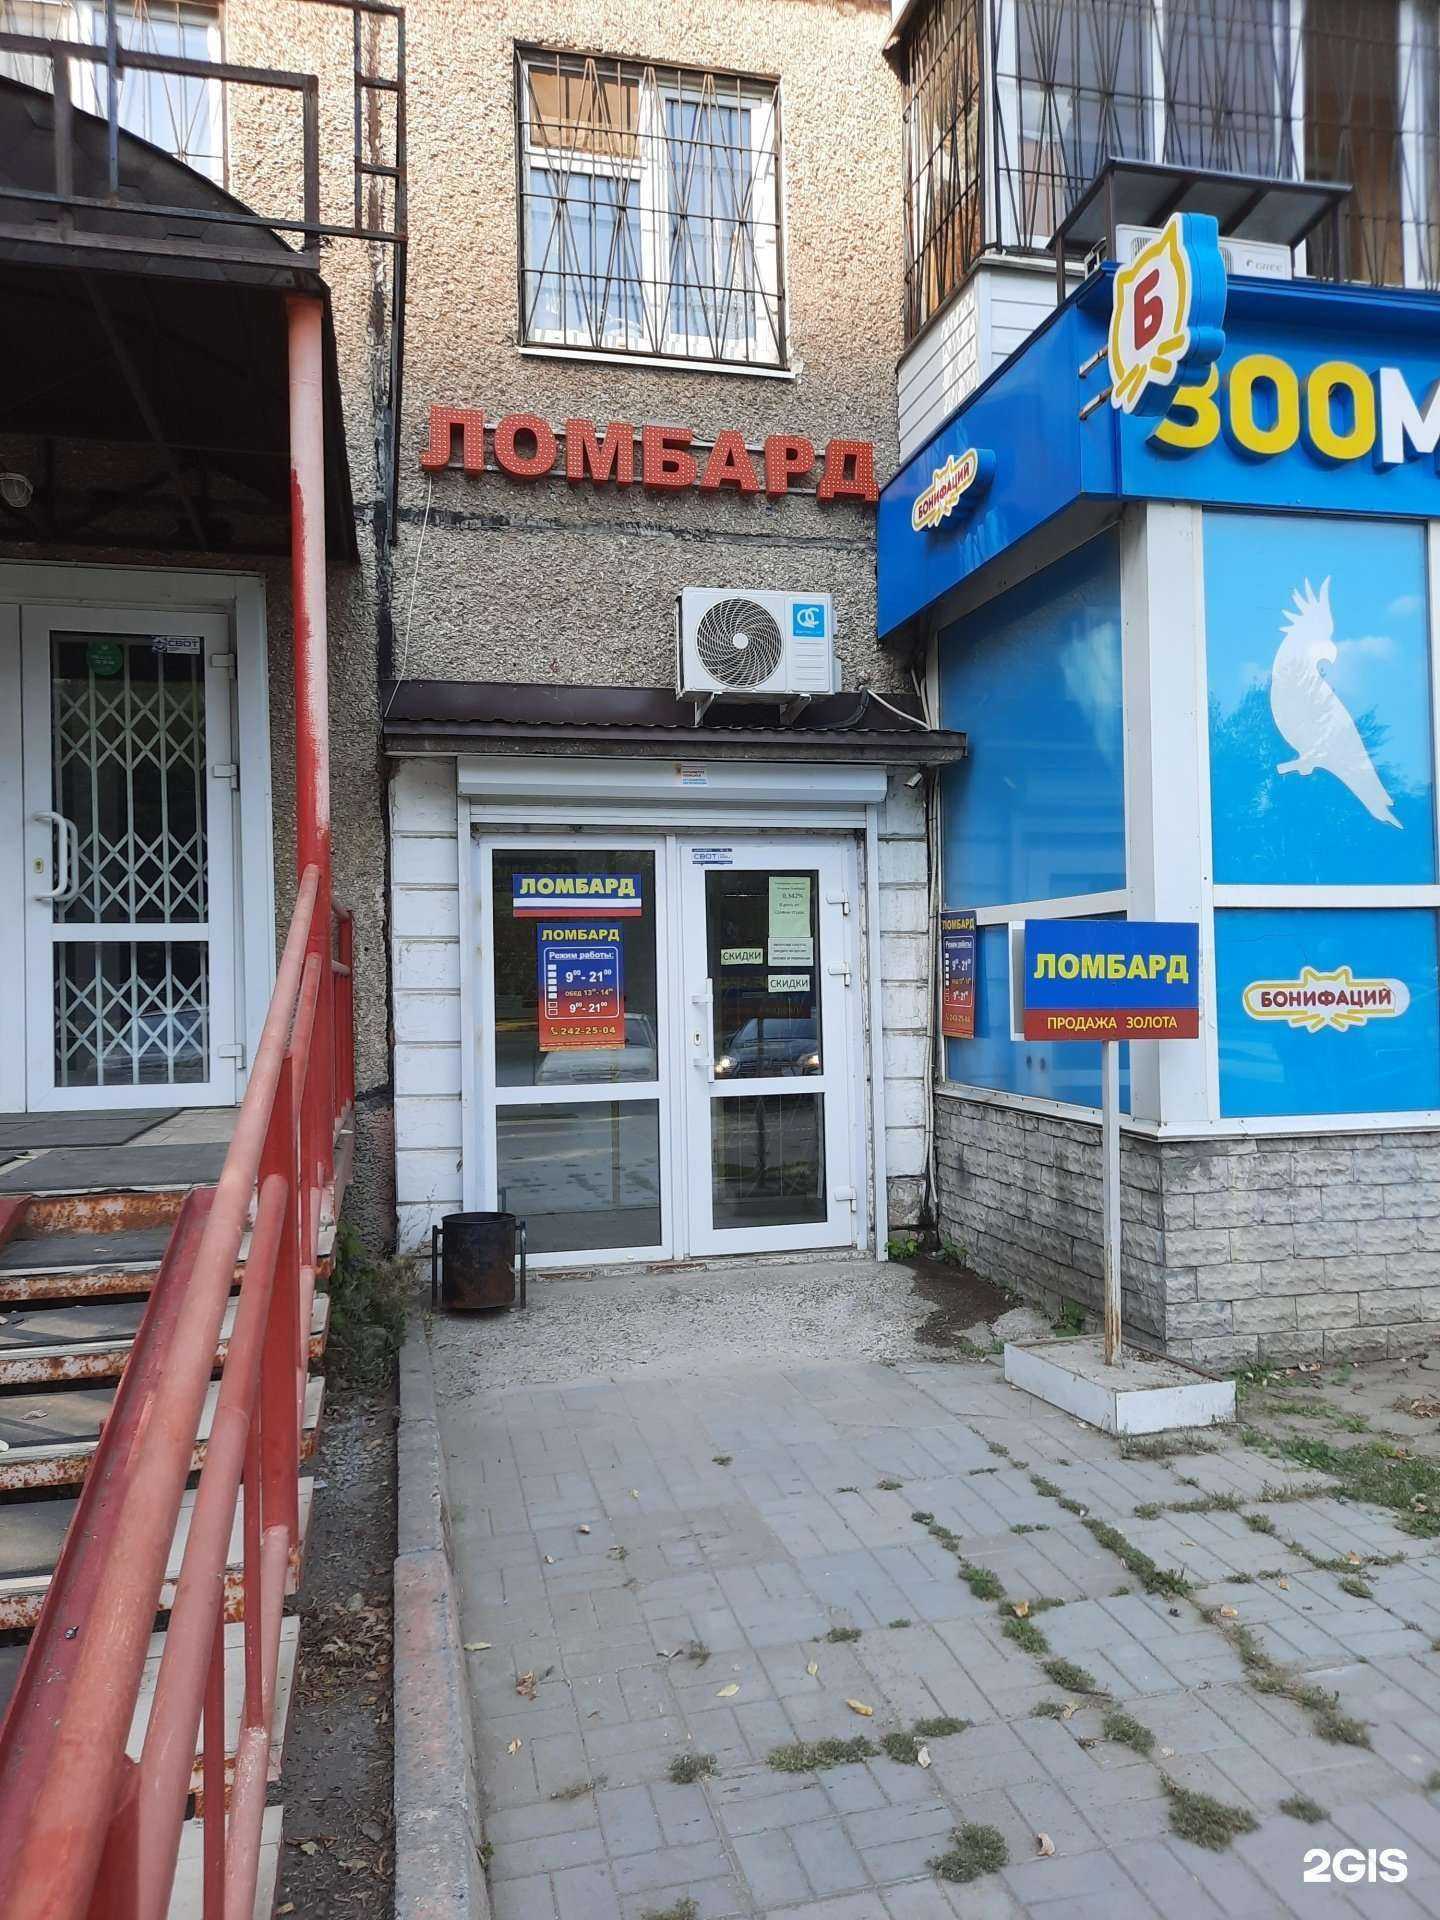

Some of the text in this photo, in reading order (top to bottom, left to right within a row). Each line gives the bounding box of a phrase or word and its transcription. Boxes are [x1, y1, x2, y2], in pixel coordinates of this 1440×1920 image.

[1133, 268, 1163, 350] Б
[420, 405, 880, 503] ЛОМБАРД
[918, 462, 970, 520] БОНИФАЦИЙ
[520, 878, 636, 897] ЛОМБАРД
[942, 918, 975, 931] ЛОМБАРД
[541, 929, 620, 942] ЛОМБАРД
[549, 950, 614, 960] Режим работы:
[722, 951, 762, 962] СКИДКИ
[1034, 952, 1188, 984] ЛОМБАРД
[770, 979, 809, 989] СКИДКИ
[1261, 988, 1392, 1008] БОНИФАЦИЙ
[1047, 1016, 1178, 1032] ПРОДАЖА ЗОЛОТА
